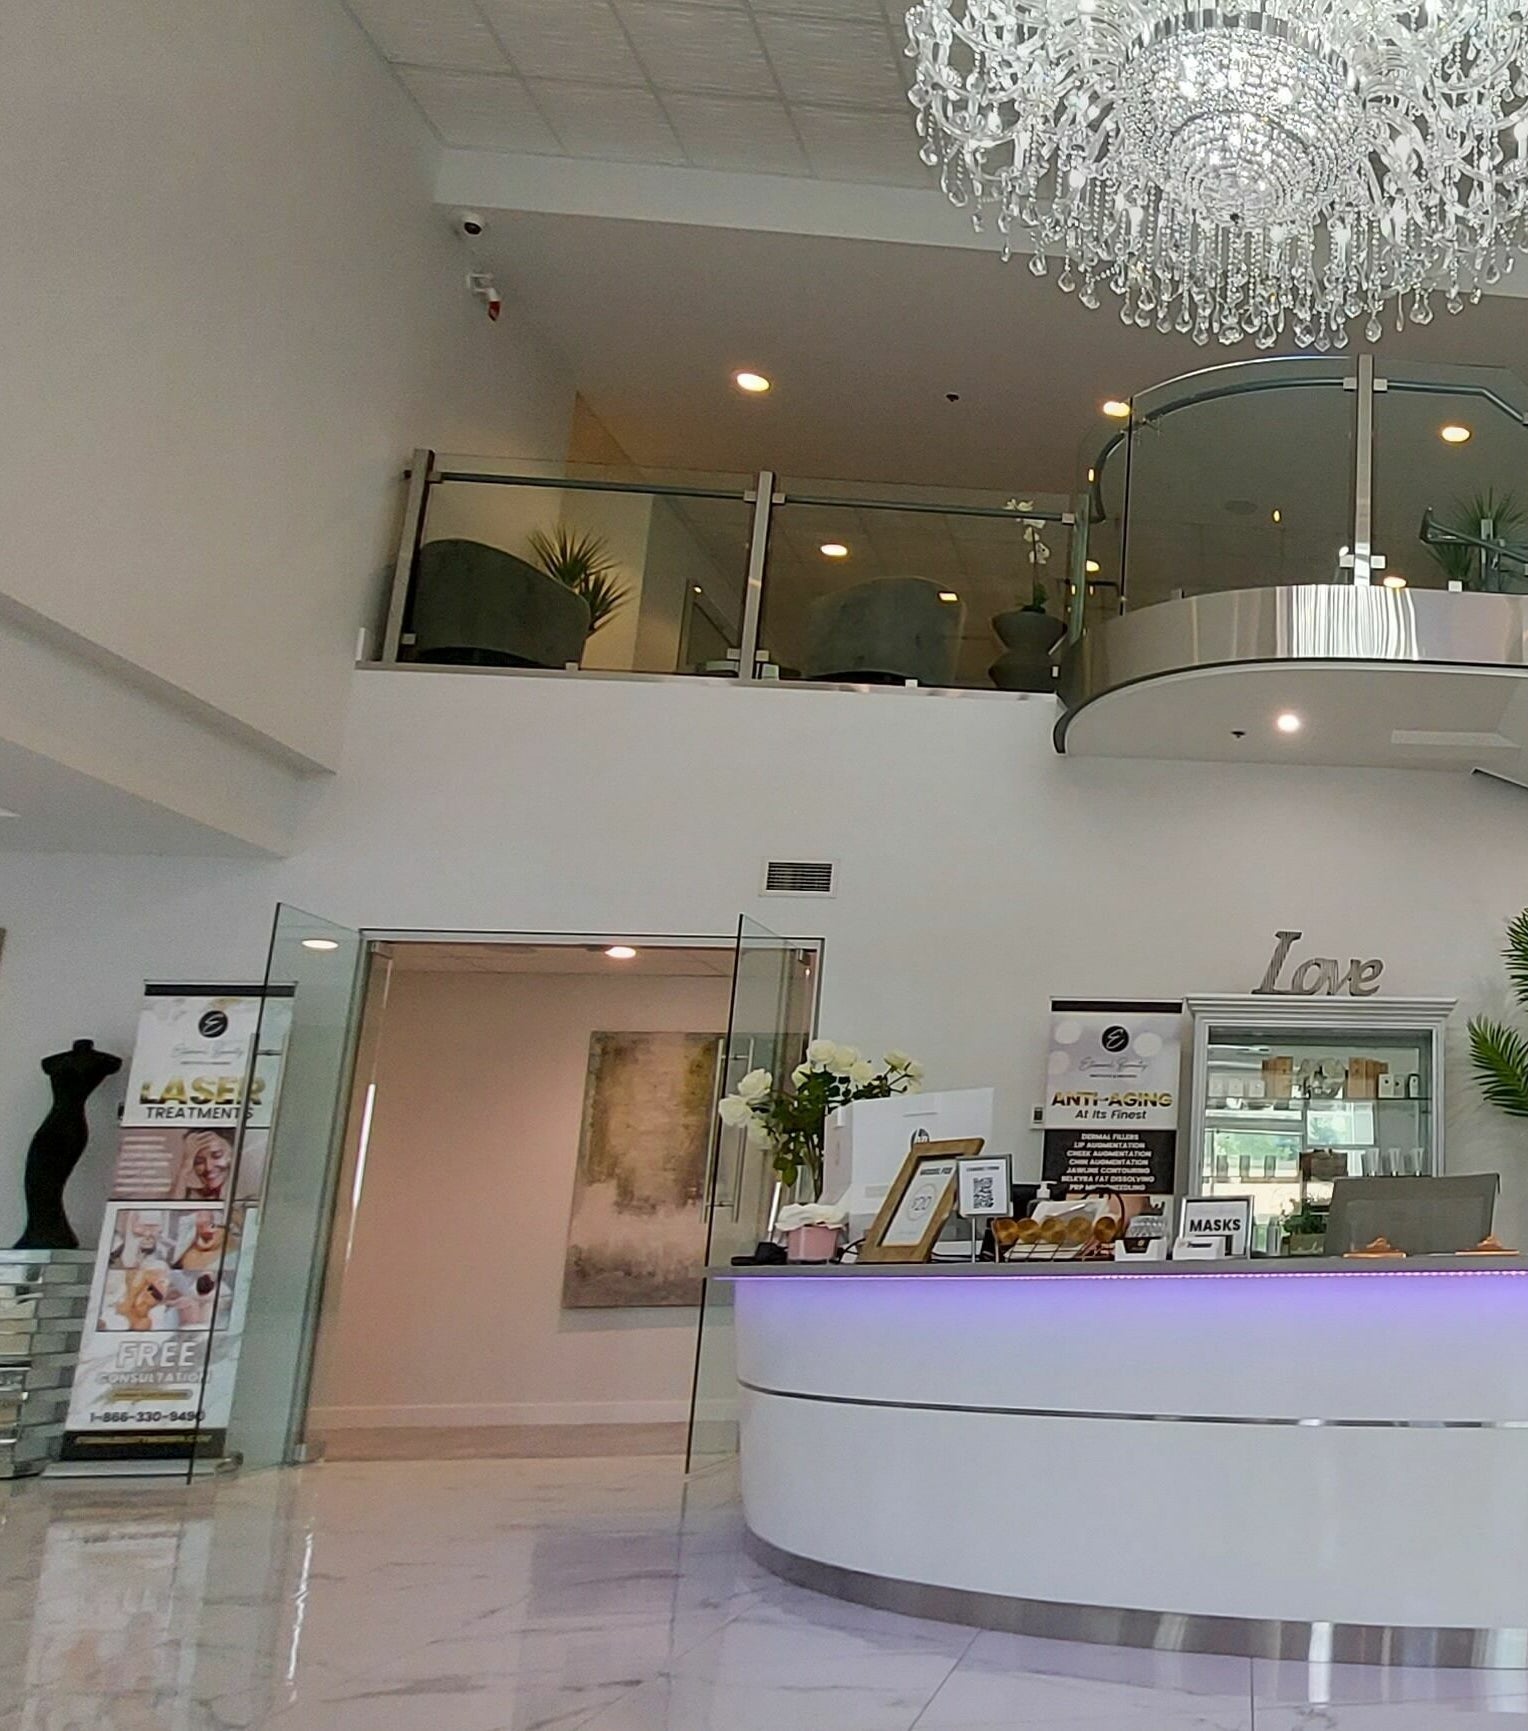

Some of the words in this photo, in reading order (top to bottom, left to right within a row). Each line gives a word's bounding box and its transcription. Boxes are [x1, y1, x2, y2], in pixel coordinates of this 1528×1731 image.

[1251, 931, 1383, 996] Love
[139, 1077, 266, 1105] LASER
[1051, 1091, 1173, 1108] ANTI-AGING
[146, 1106, 254, 1120] TREATMENTS
[1075, 1110, 1089, 1119] At
[1092, 1110, 1107, 1119] Its
[1110, 1110, 1147, 1120] Finest
[1189, 1219, 1241, 1232] MASKS
[116, 1340, 198, 1368] FREE
